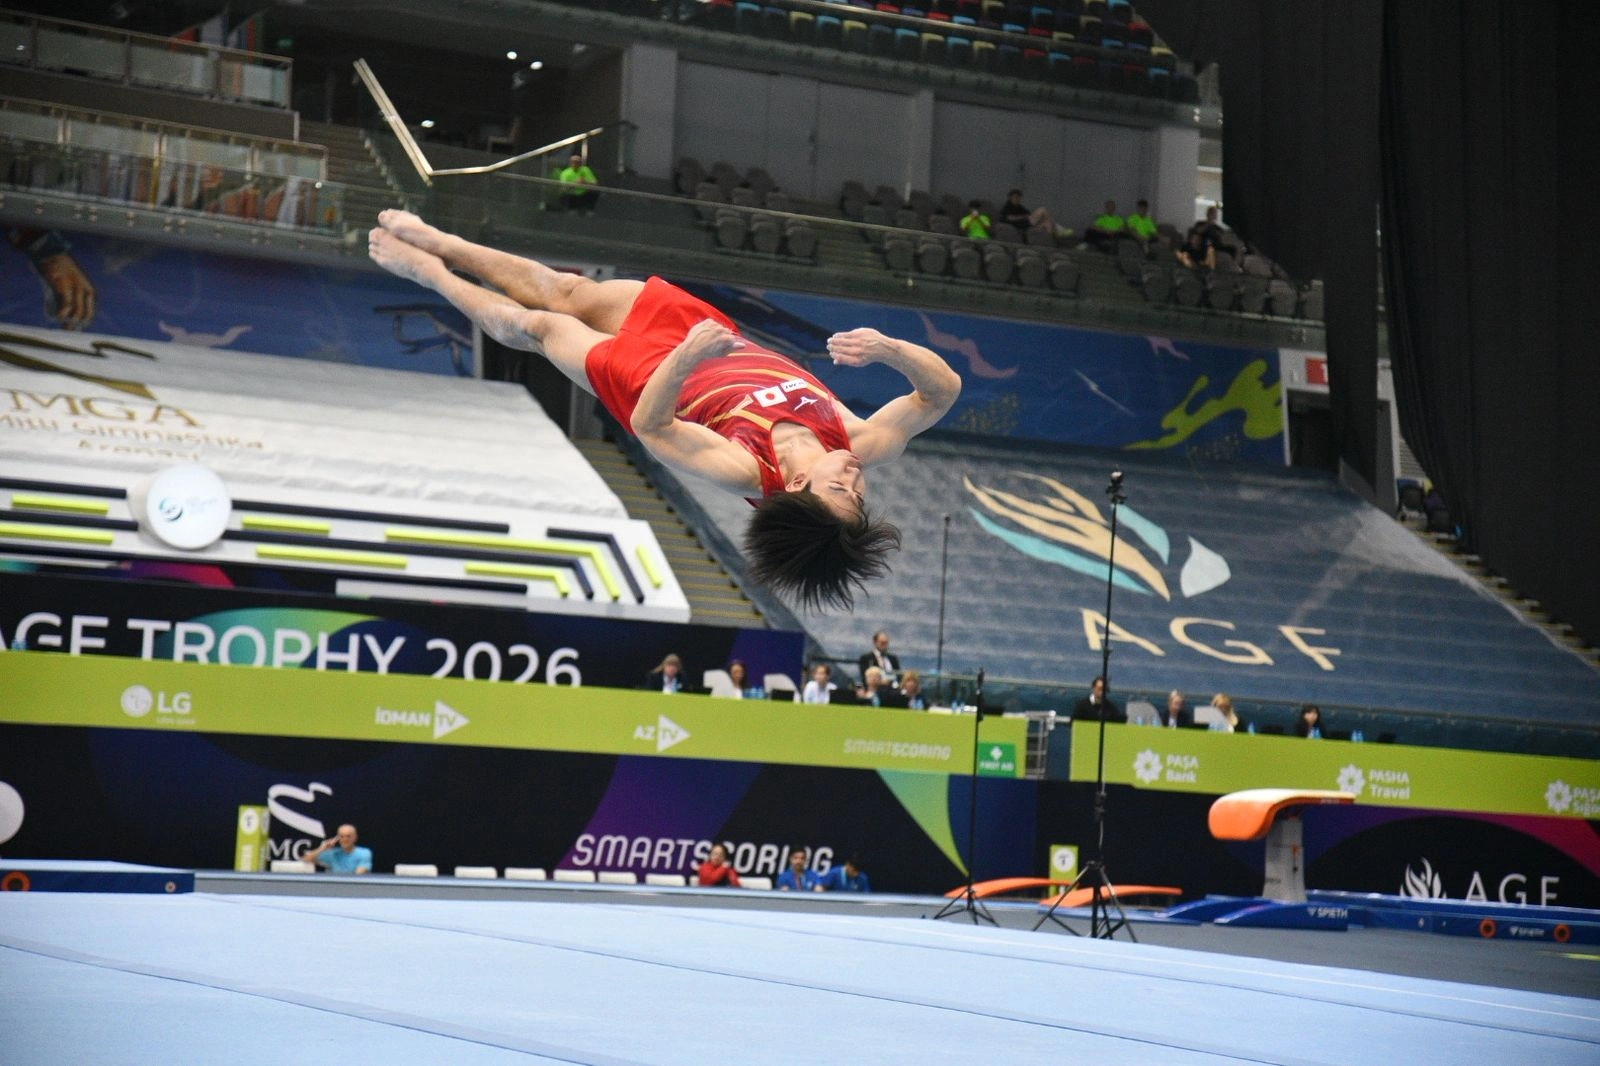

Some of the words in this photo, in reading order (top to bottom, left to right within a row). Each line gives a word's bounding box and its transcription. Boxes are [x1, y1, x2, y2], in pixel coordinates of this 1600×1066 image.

[7, 388, 205, 428] MGA
[1080, 608, 1342, 671] AGF
[0, 611, 109, 657] GF
[126, 618, 406, 675] TROPHY
[425, 638, 582, 688] 2026
[158, 691, 192, 714] LG
[633, 725, 655, 740] AZ
[1166, 769, 1198, 783] Bank
[1369, 769, 1410, 784] PASHA
[1371, 785, 1410, 800] Travel
[1466, 871, 1560, 907] AGF
[1318, 907, 1348, 919] SPIETH
